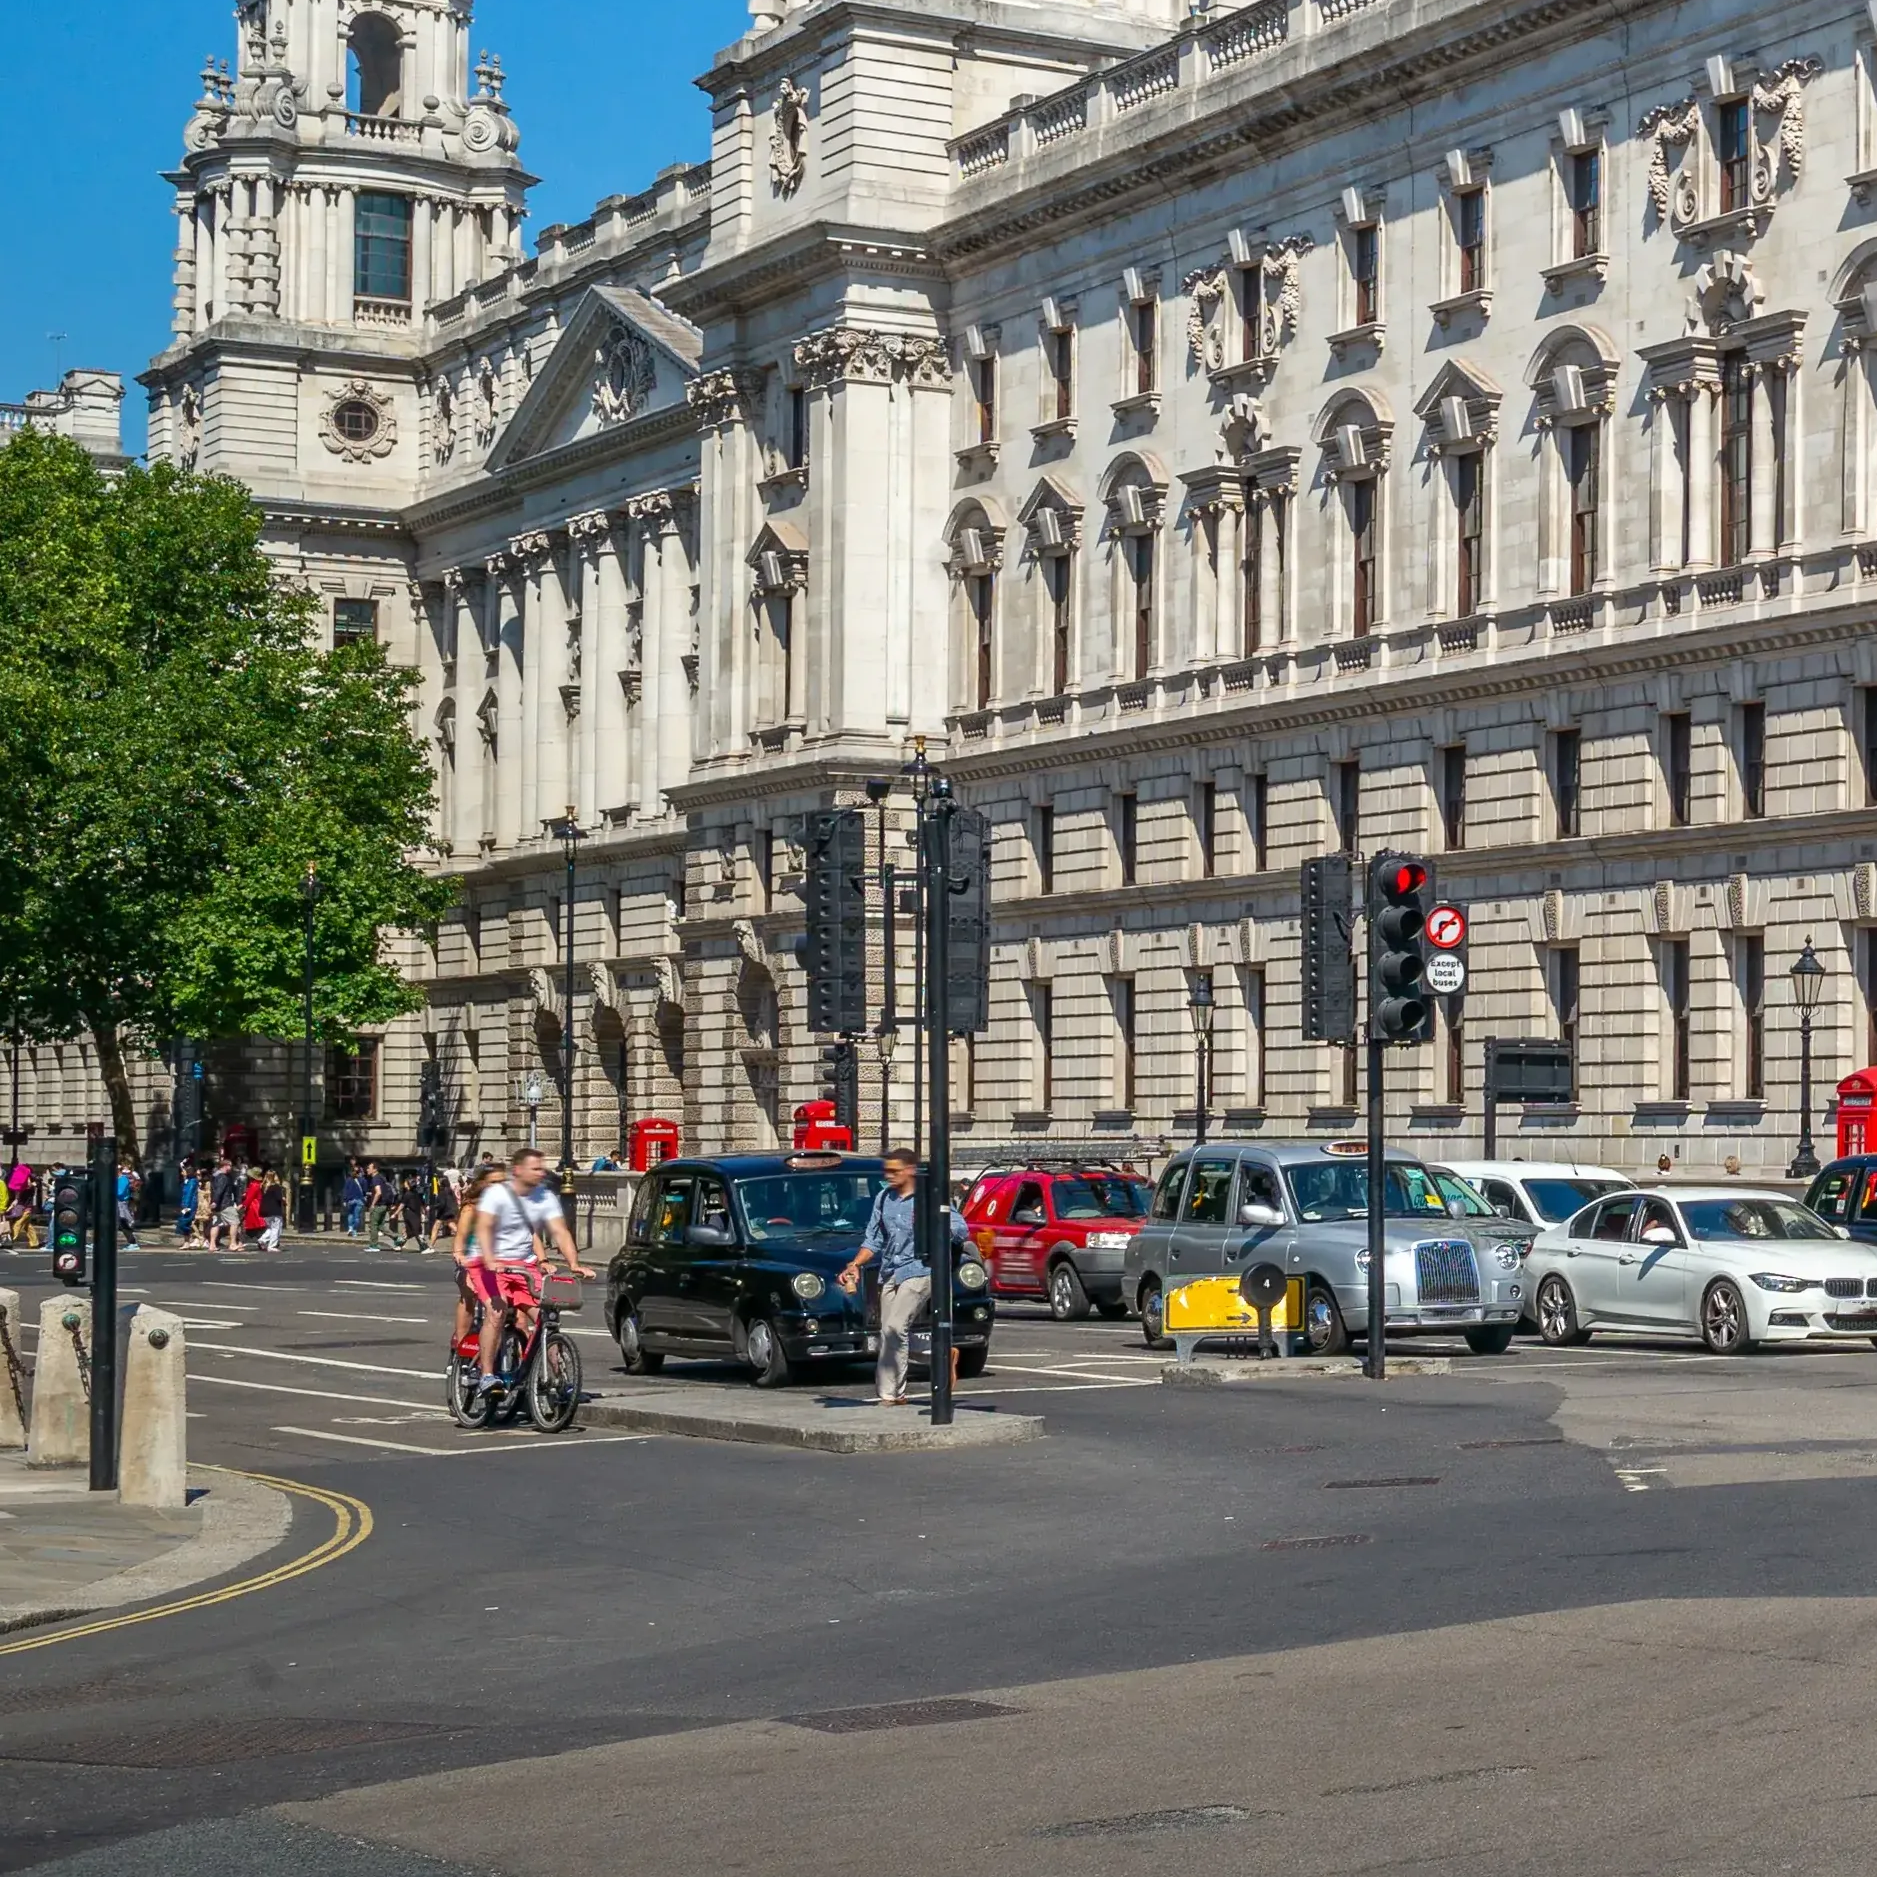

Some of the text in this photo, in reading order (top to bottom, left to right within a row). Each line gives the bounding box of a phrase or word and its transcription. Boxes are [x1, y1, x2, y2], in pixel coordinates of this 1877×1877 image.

[1430, 959, 1461, 968] Except
[1434, 969, 1456, 977] local
[1432, 978, 1458, 987] buses
[1263, 1278, 1271, 1289] 4
